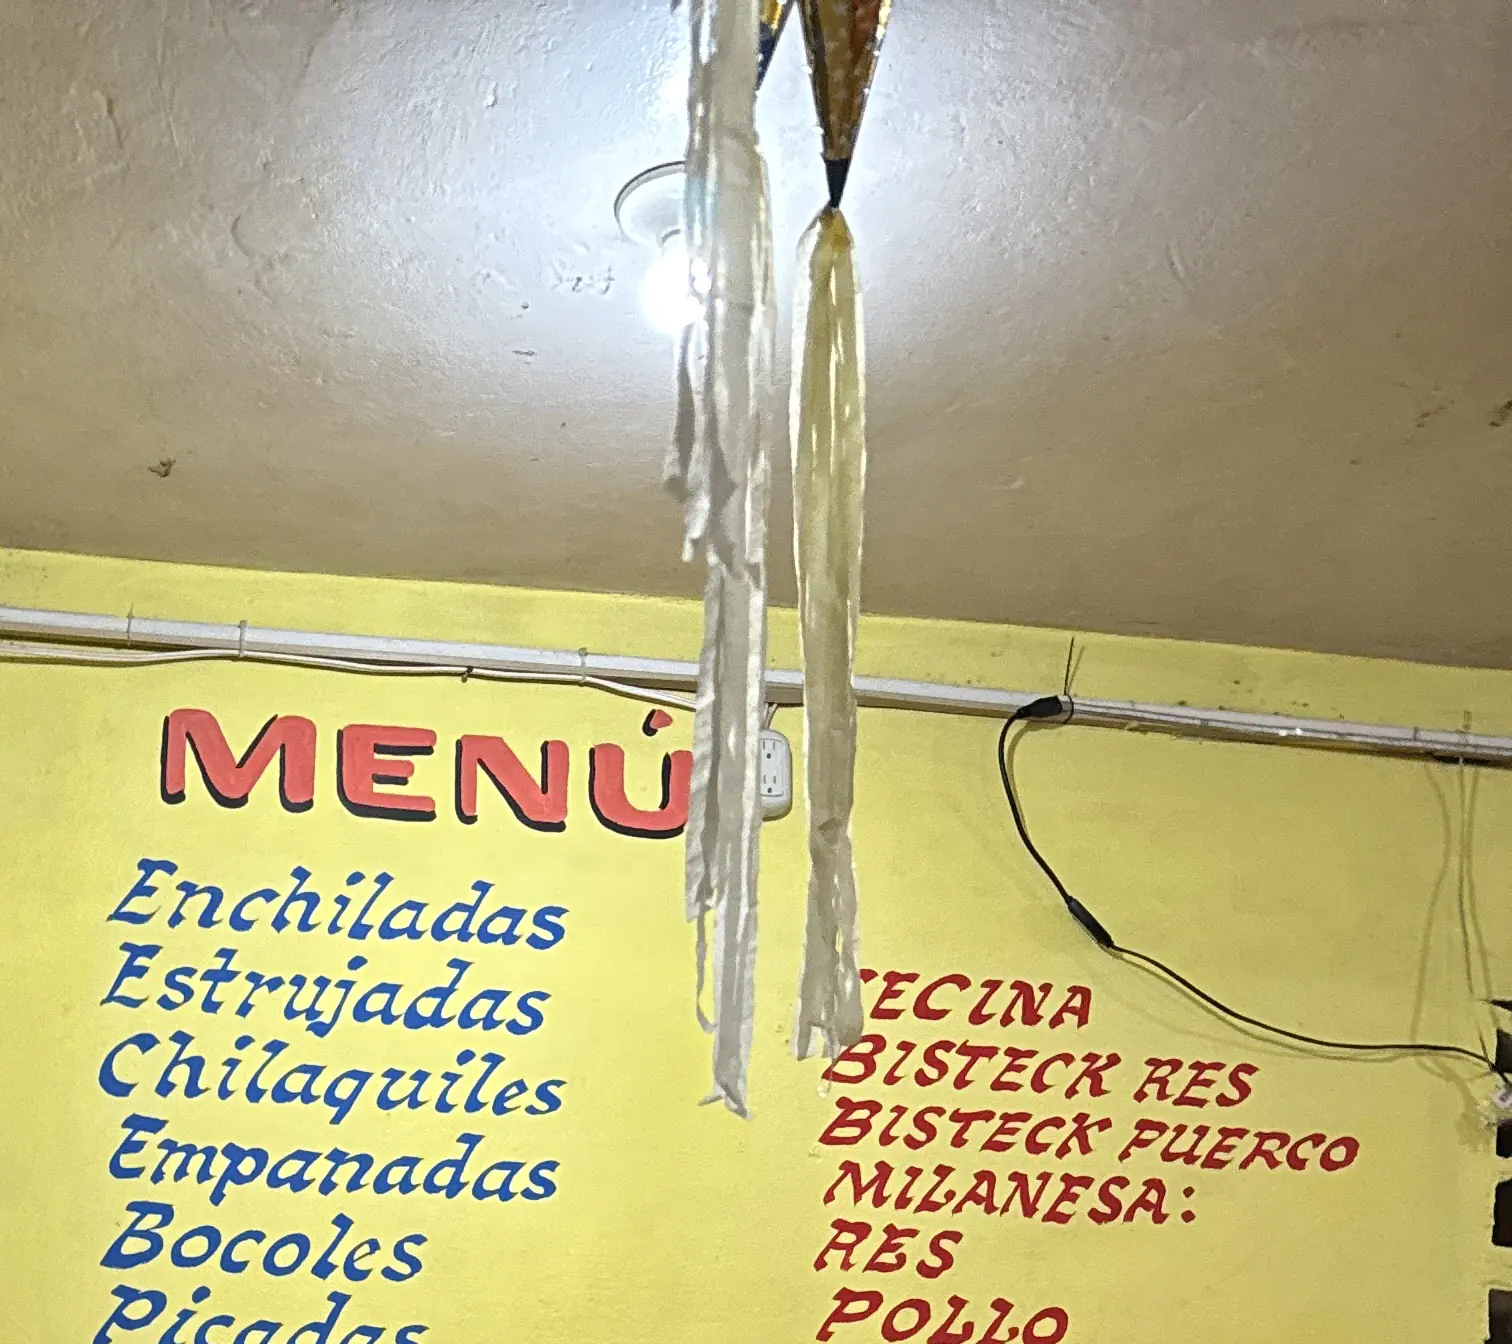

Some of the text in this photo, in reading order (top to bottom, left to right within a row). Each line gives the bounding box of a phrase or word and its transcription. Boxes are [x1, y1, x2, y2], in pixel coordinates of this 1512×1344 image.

[160, 707, 695, 839] MENÚ
[107, 857, 569, 950] Enchiladas
[100, 942, 552, 1038] Estrujadas
[859, 967, 1093, 1030] ECINA
[98, 1030, 568, 1125] Chilaquiles
[821, 1033, 1260, 1108] BISTECK RES
[107, 1113, 561, 1206] Empanadas
[818, 1097, 1361, 1173] BISTECK PUERCO
[822, 1159, 1196, 1226] MILANESA:
[99, 1199, 428, 1282] Bocoles
[813, 1217, 964, 1280] RES
